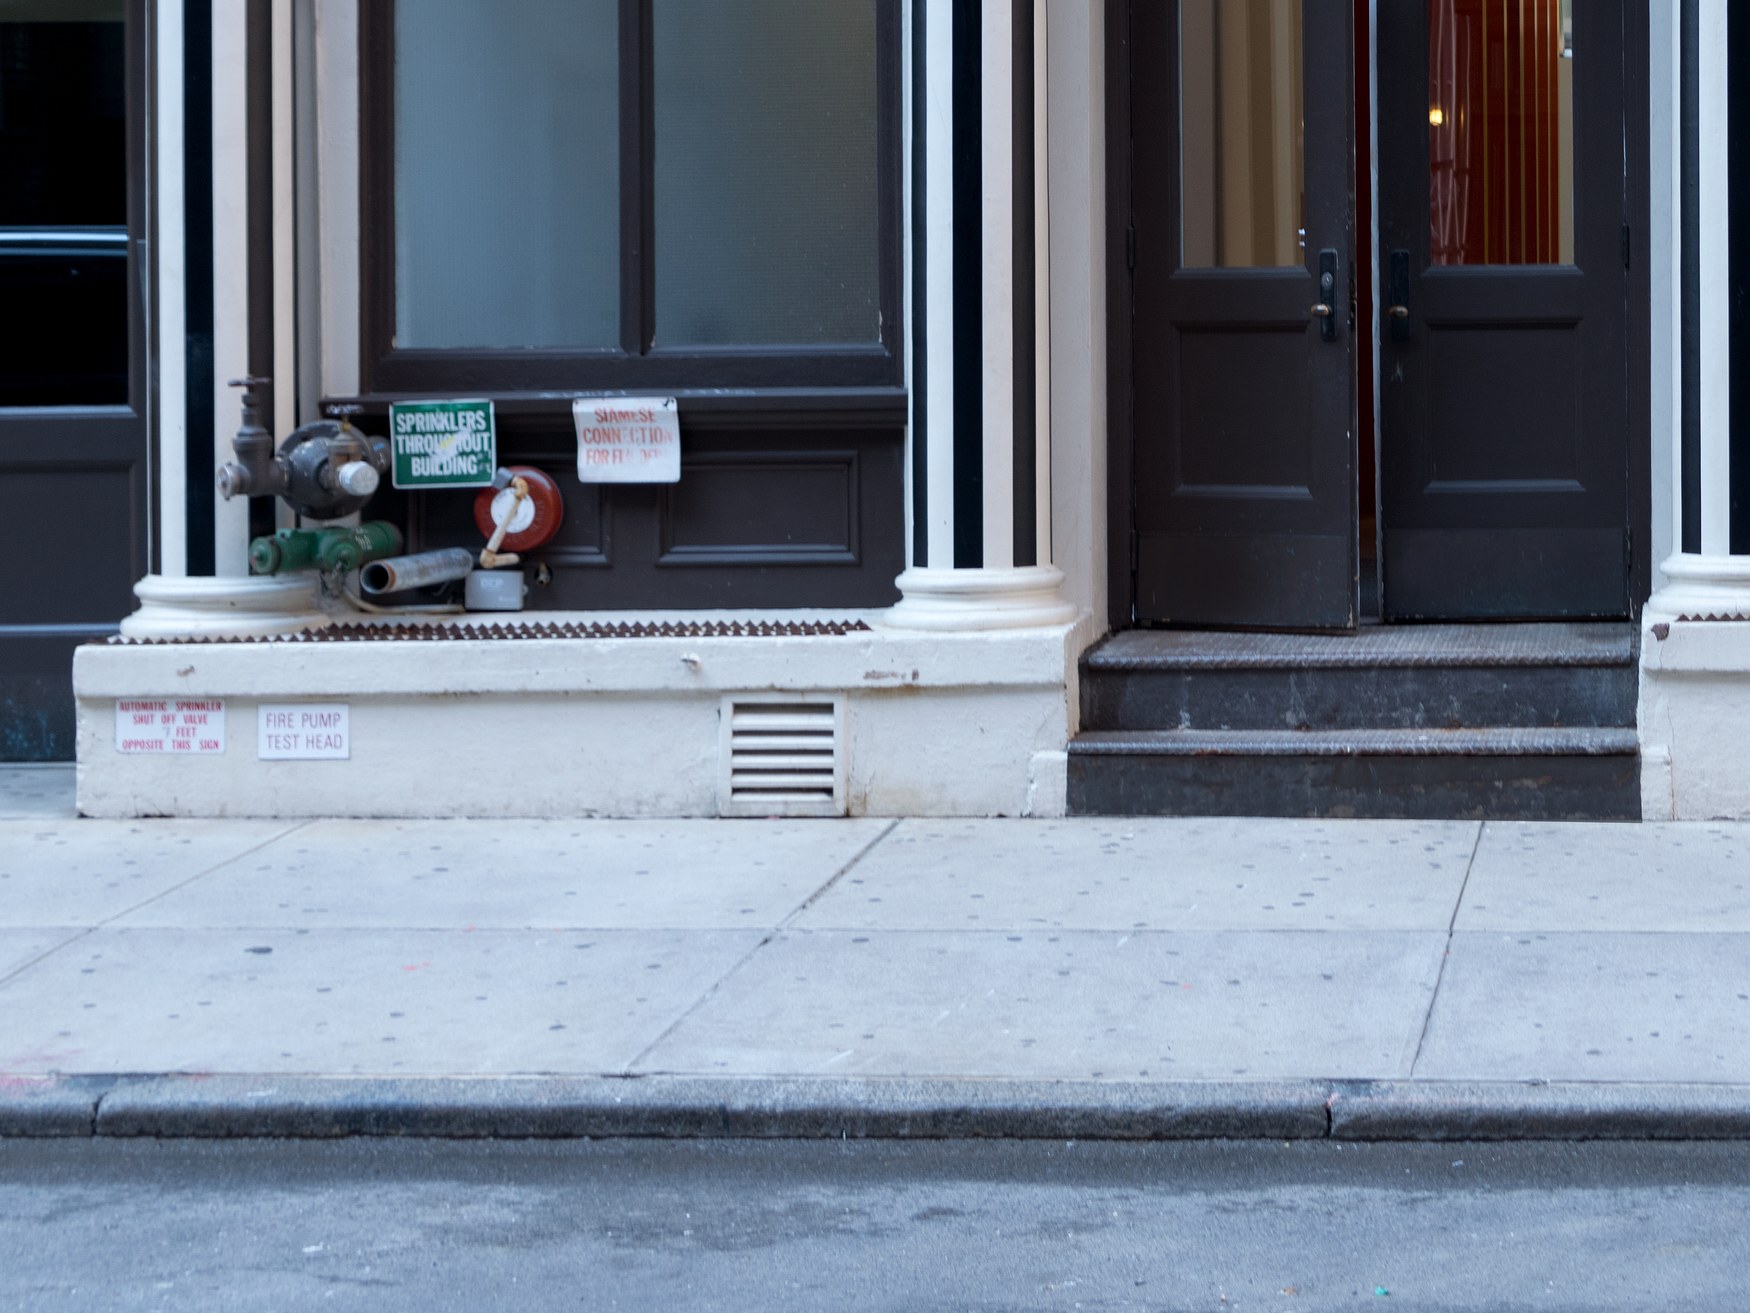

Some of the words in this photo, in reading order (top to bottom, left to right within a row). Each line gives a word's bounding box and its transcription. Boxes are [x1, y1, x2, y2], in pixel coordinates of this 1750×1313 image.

[396, 410, 487, 433] SPRINKLERS
[586, 448, 609, 465] FOR
[411, 454, 478, 477] BUILDING
[119, 700, 167, 712] AUTOMATIC
[175, 700, 222, 712] SPRINKLER
[132, 713, 154, 725] SHUT
[161, 713, 176, 725] OFF
[183, 713, 208, 725] VALVE
[266, 712, 295, 729] FIRE
[301, 712, 341, 729] PUMP
[176, 726, 196, 737] FEET
[122, 739, 164, 751] OPPOSITE
[172, 739, 191, 751] THIS
[199, 739, 219, 751] SIGN
[267, 734, 300, 750] TEST
[305, 734, 343, 750] HEAD
